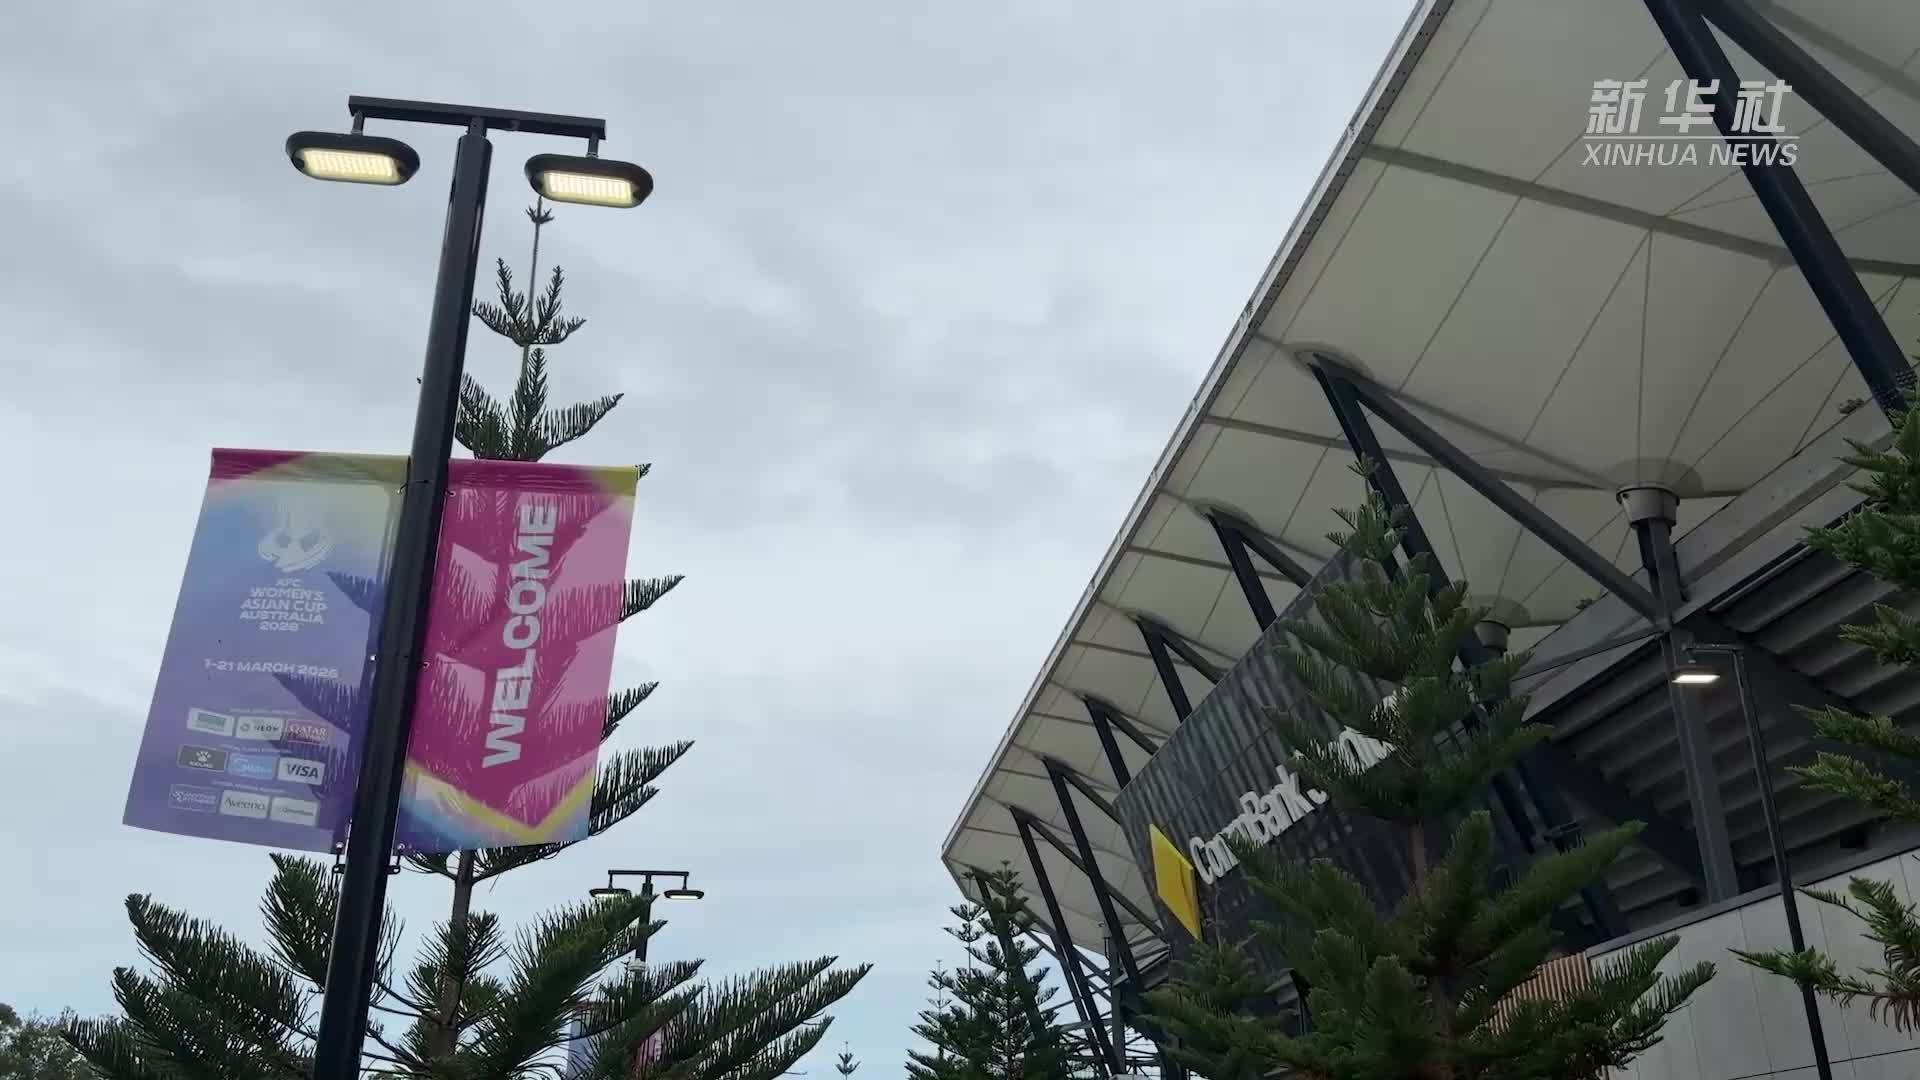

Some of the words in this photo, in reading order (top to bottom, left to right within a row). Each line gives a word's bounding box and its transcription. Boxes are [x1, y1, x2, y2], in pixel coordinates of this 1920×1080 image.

[240, 598, 290, 611] ASIAN
[293, 600, 328, 613] CUP
[239, 610, 325, 625] AUSTRALIA
[482, 502, 558, 768] WELCOME
[236, 660, 295, 673] MARCH
[297, 664, 338, 679] 2026
[289, 723, 328, 738] QATAR
[287, 763, 319, 779] VISA
[223, 796, 266, 811] Aveeno
